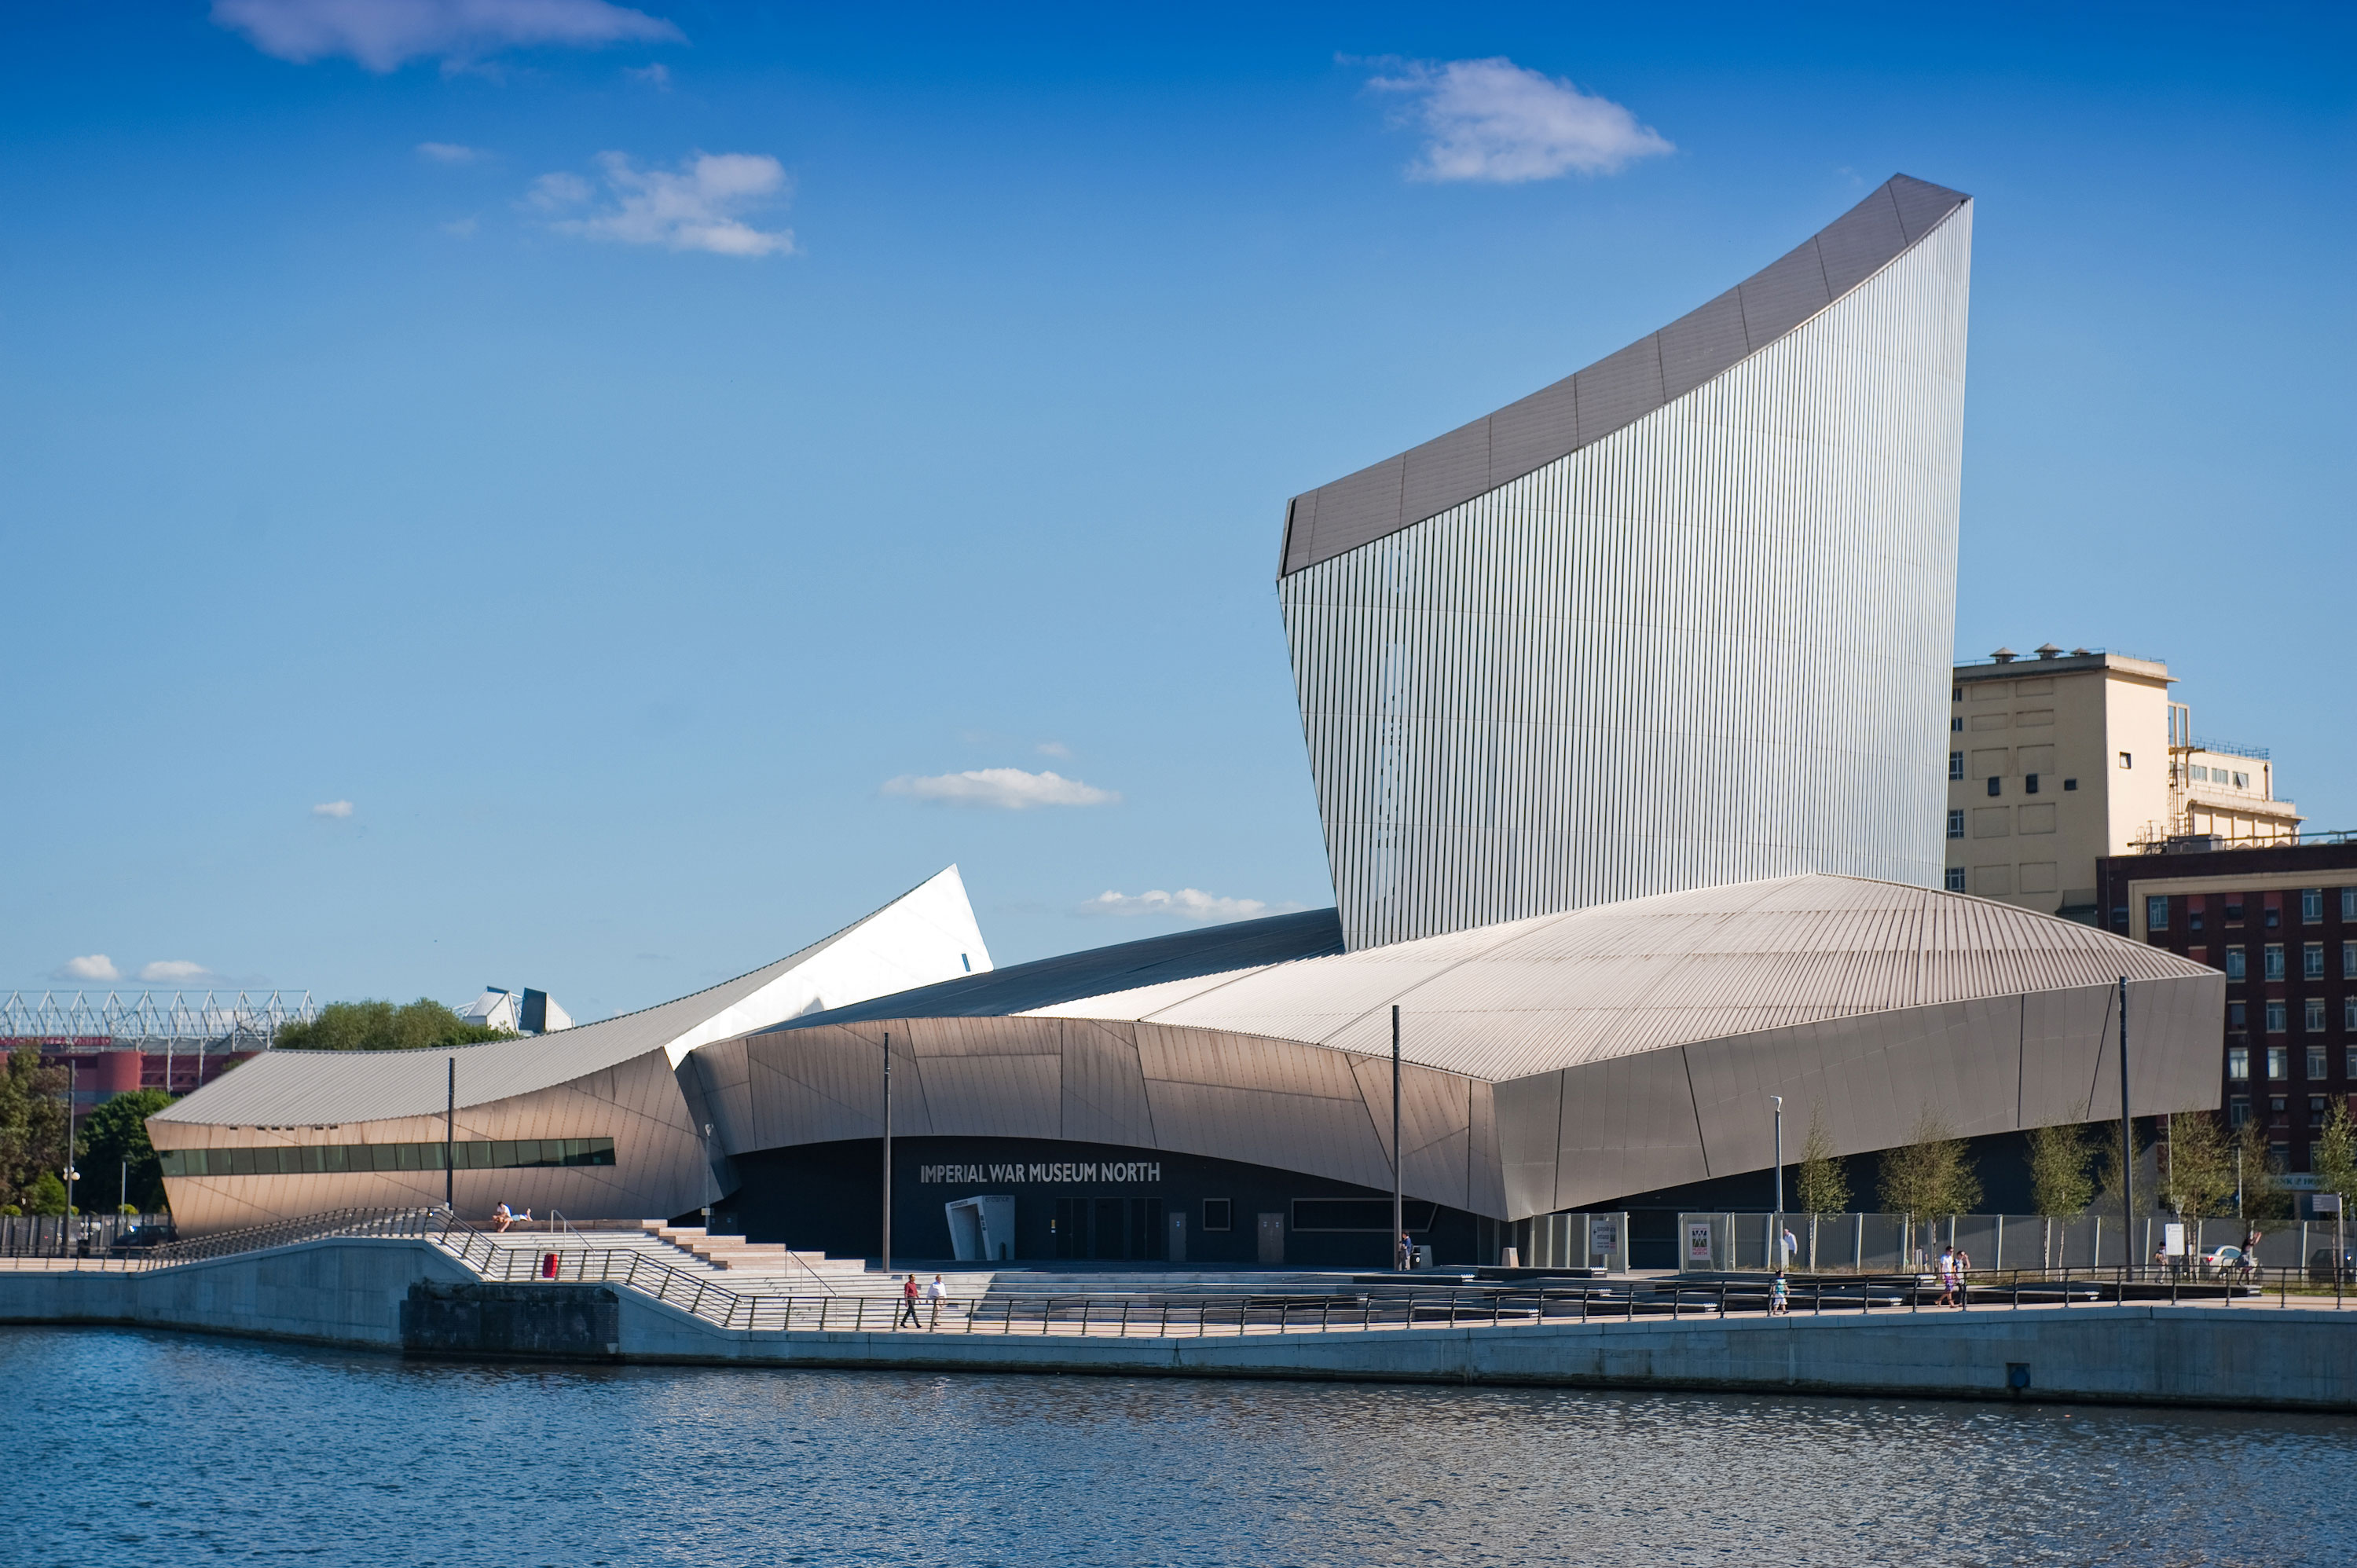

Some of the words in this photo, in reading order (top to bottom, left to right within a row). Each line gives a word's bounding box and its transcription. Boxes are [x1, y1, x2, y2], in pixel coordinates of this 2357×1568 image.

[921, 1163, 988, 1182] IMPERIAL
[988, 1163, 1025, 1182] WAR
[1029, 1163, 1097, 1182] MUSEUM
[1102, 1162, 1160, 1181] NORTH
